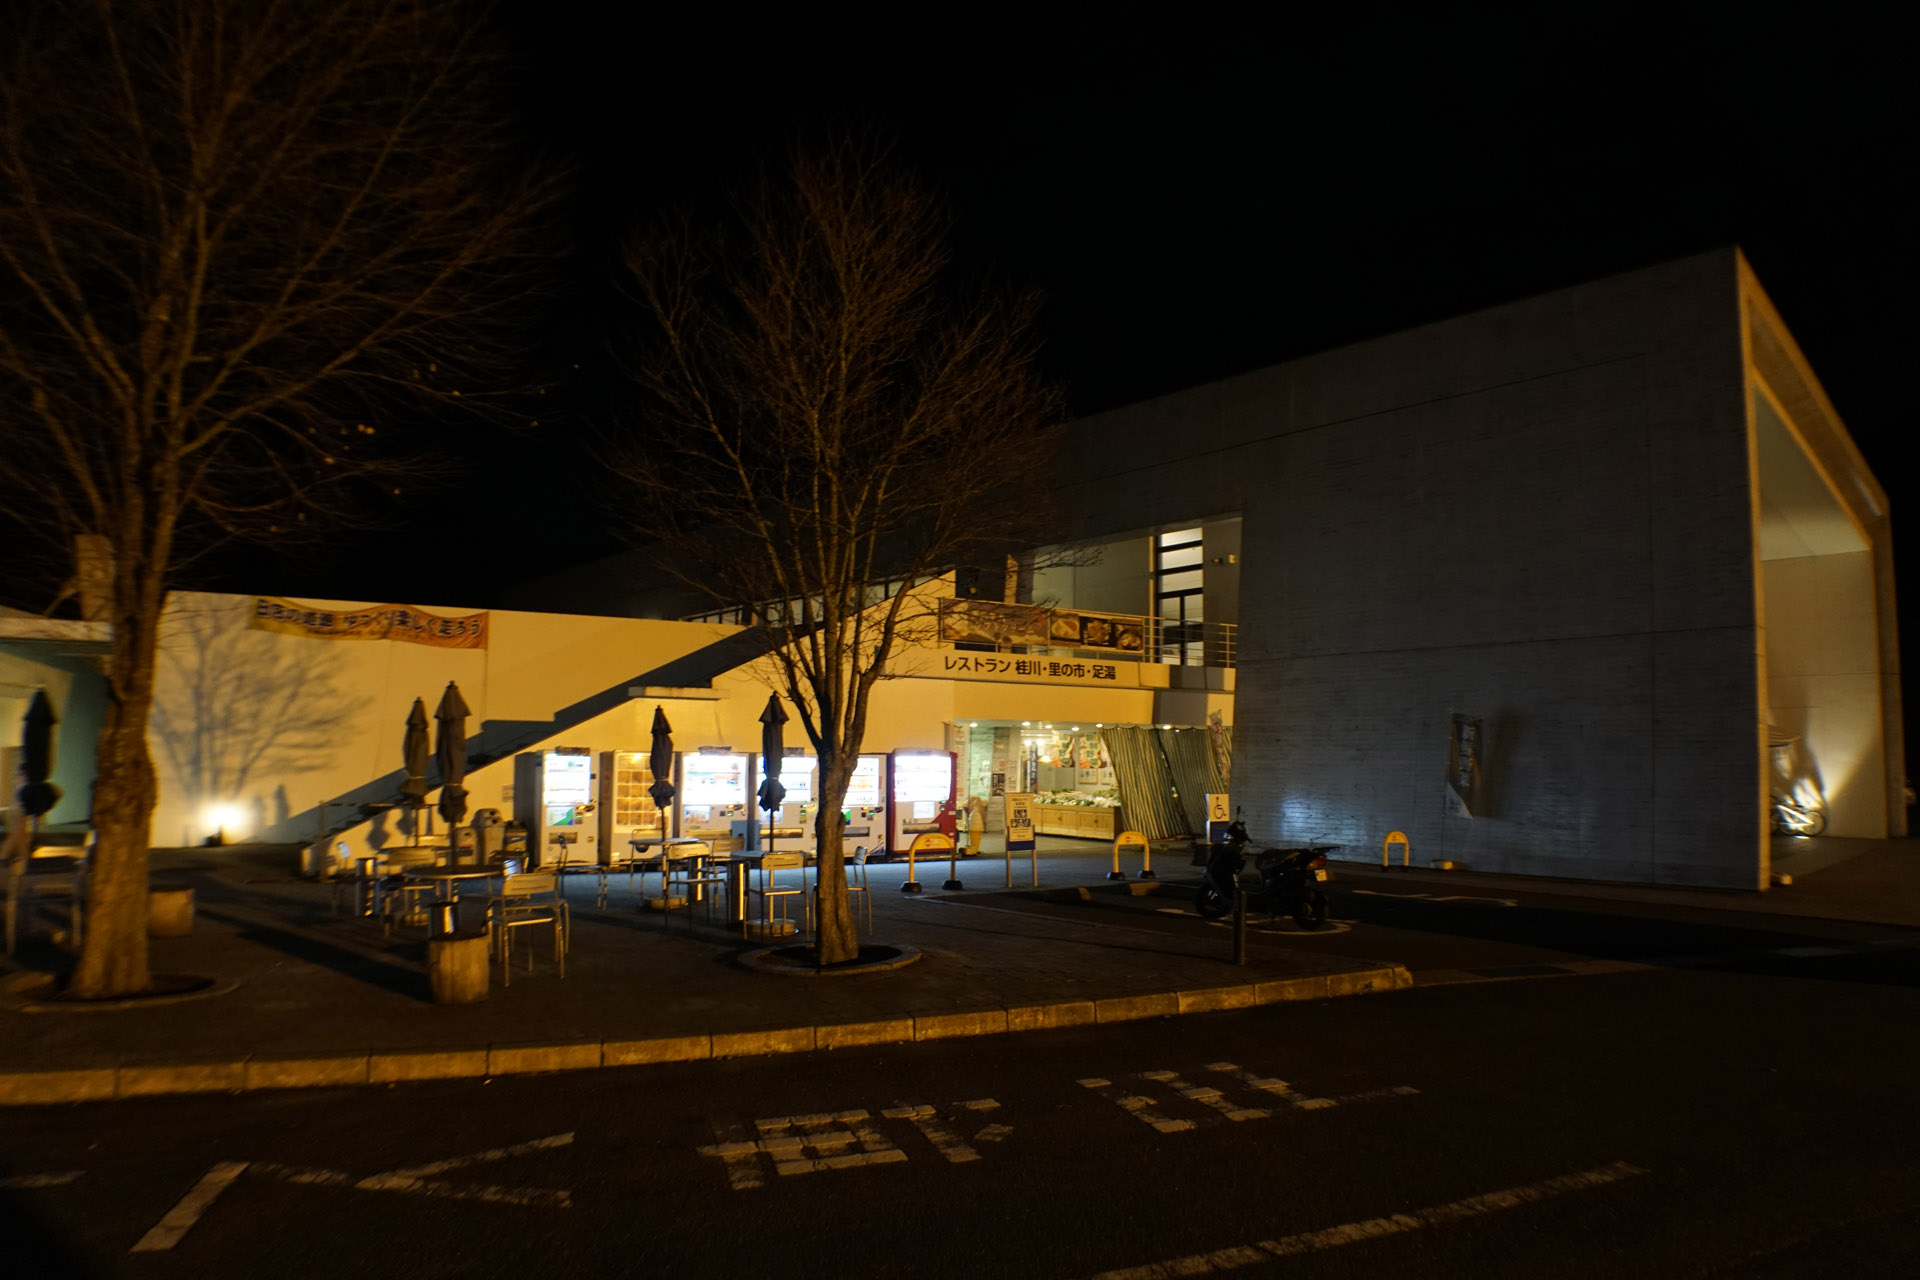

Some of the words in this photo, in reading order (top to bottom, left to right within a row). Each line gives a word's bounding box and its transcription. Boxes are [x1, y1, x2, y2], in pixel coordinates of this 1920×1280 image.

[944, 655, 1011, 673] レストラン
[1015, 659, 1116, 680] 桂川・里の市・足湯
